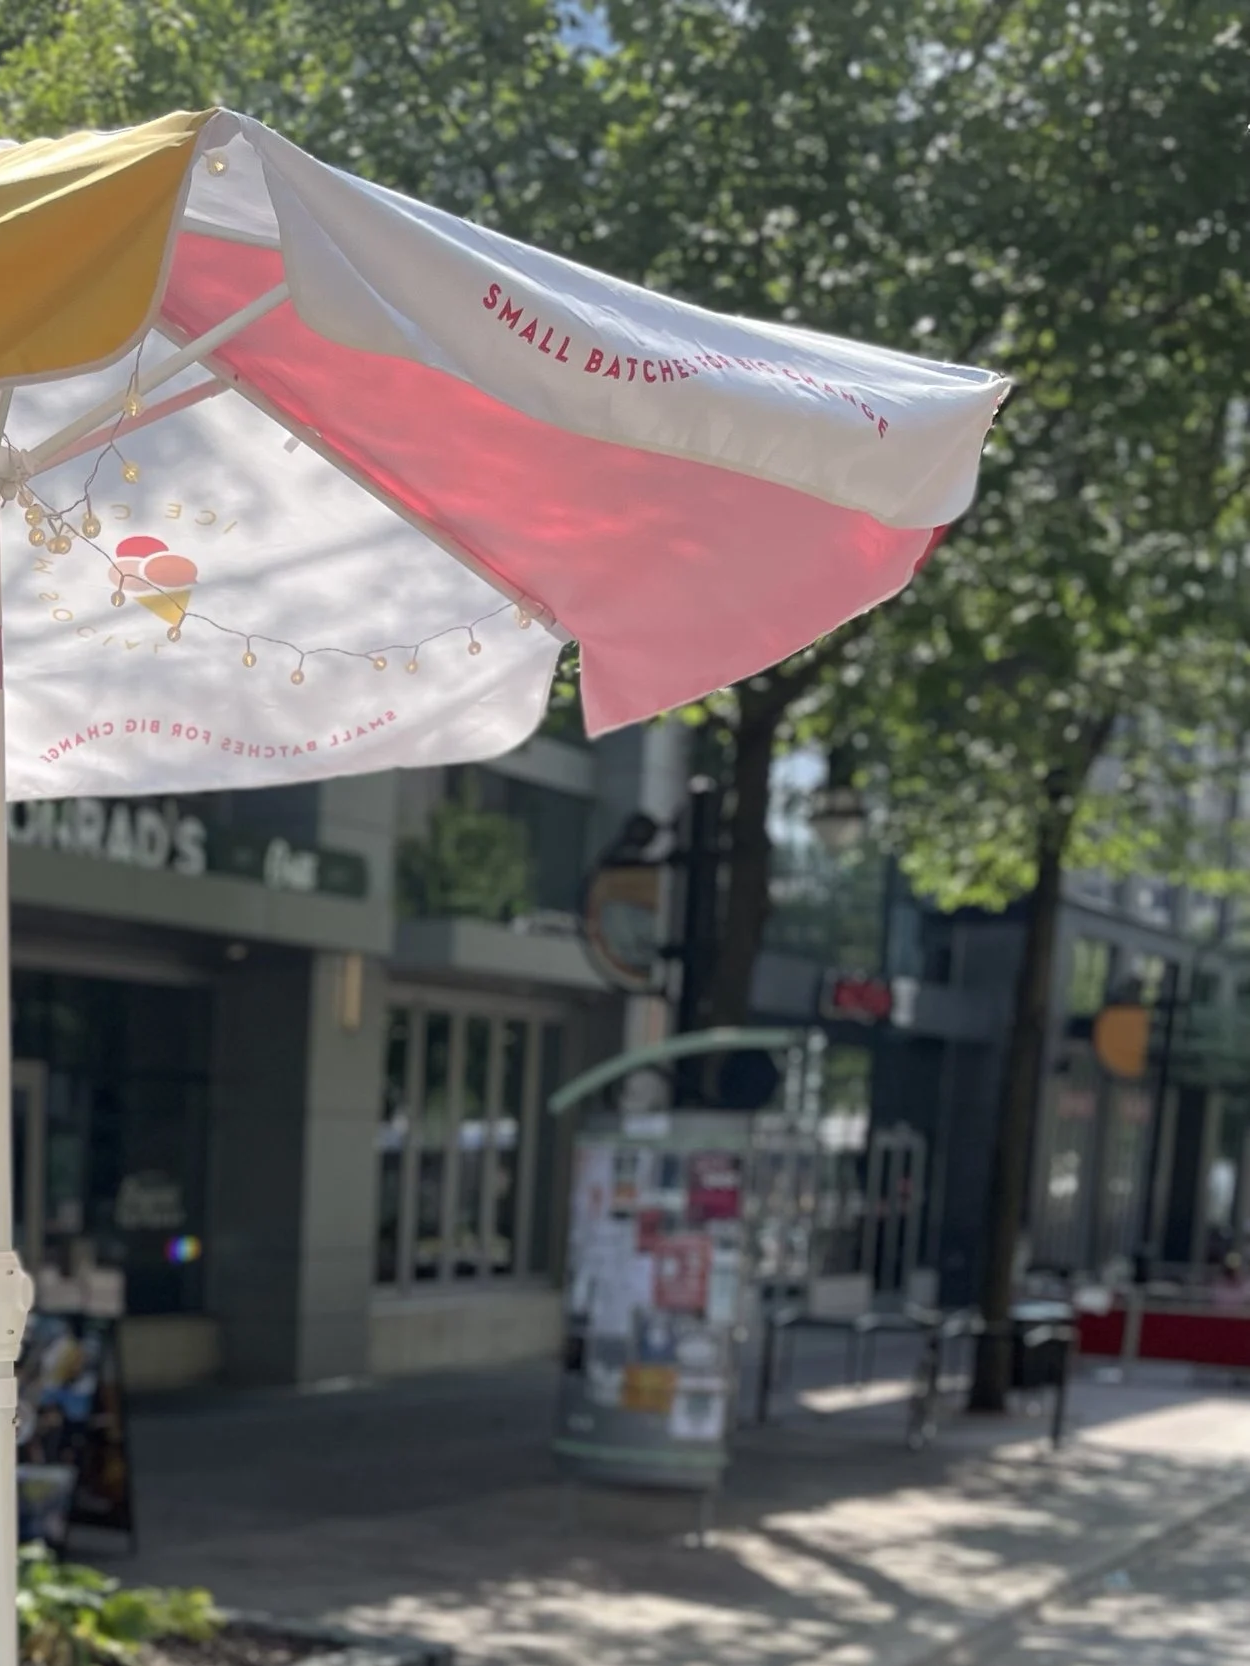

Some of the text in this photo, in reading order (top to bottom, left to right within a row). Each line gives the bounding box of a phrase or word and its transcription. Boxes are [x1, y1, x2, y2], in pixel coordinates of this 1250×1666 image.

[482, 283, 889, 439] SMALL BATCHES FOR BIG CHANGE
